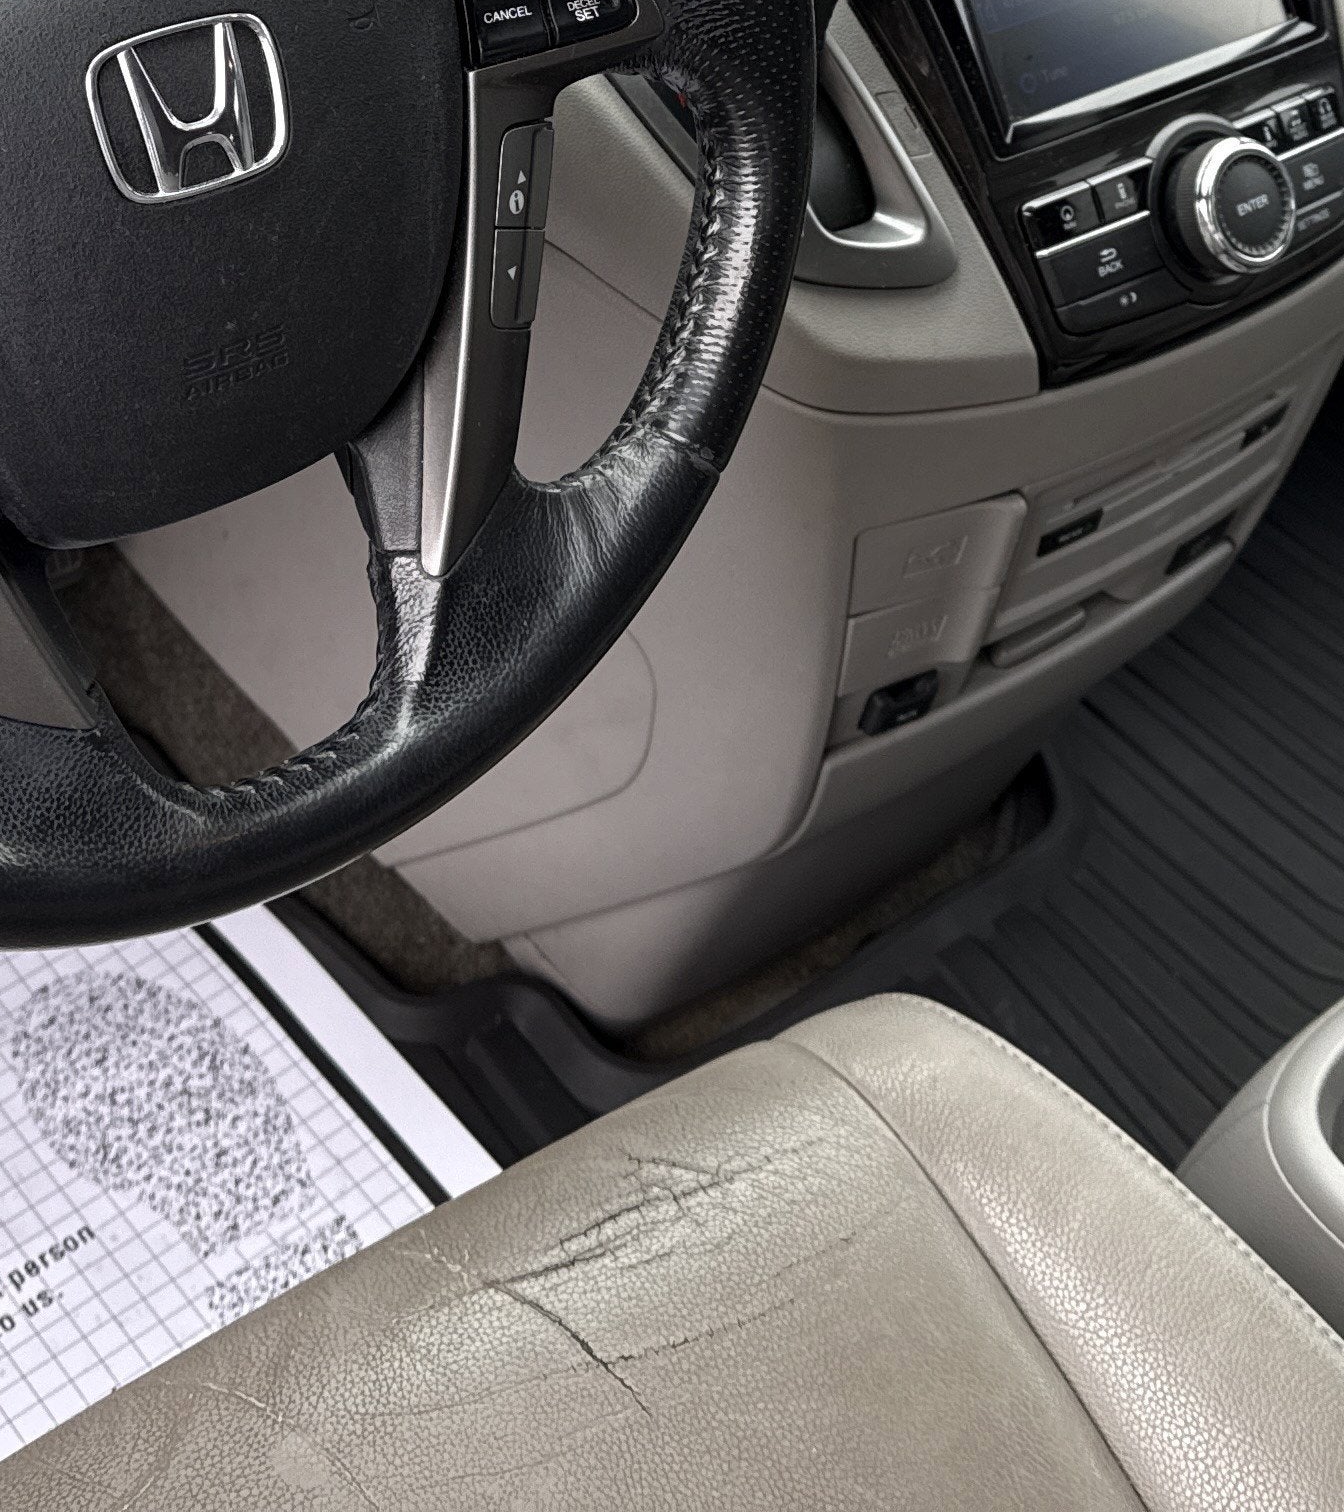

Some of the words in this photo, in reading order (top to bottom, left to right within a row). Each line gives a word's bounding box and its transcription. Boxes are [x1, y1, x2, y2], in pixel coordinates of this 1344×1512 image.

[483, 5, 532, 24] CANCEL
[575, 7, 601, 22] SET
[1237, 193, 1269, 217] ENTER
[1098, 259, 1124, 278] BACK
[184, 325, 289, 380] SRS
[184, 356, 291, 402] AIRBAG
[8, 1225, 96, 1291] person
[19, 1289, 64, 1319] us.
